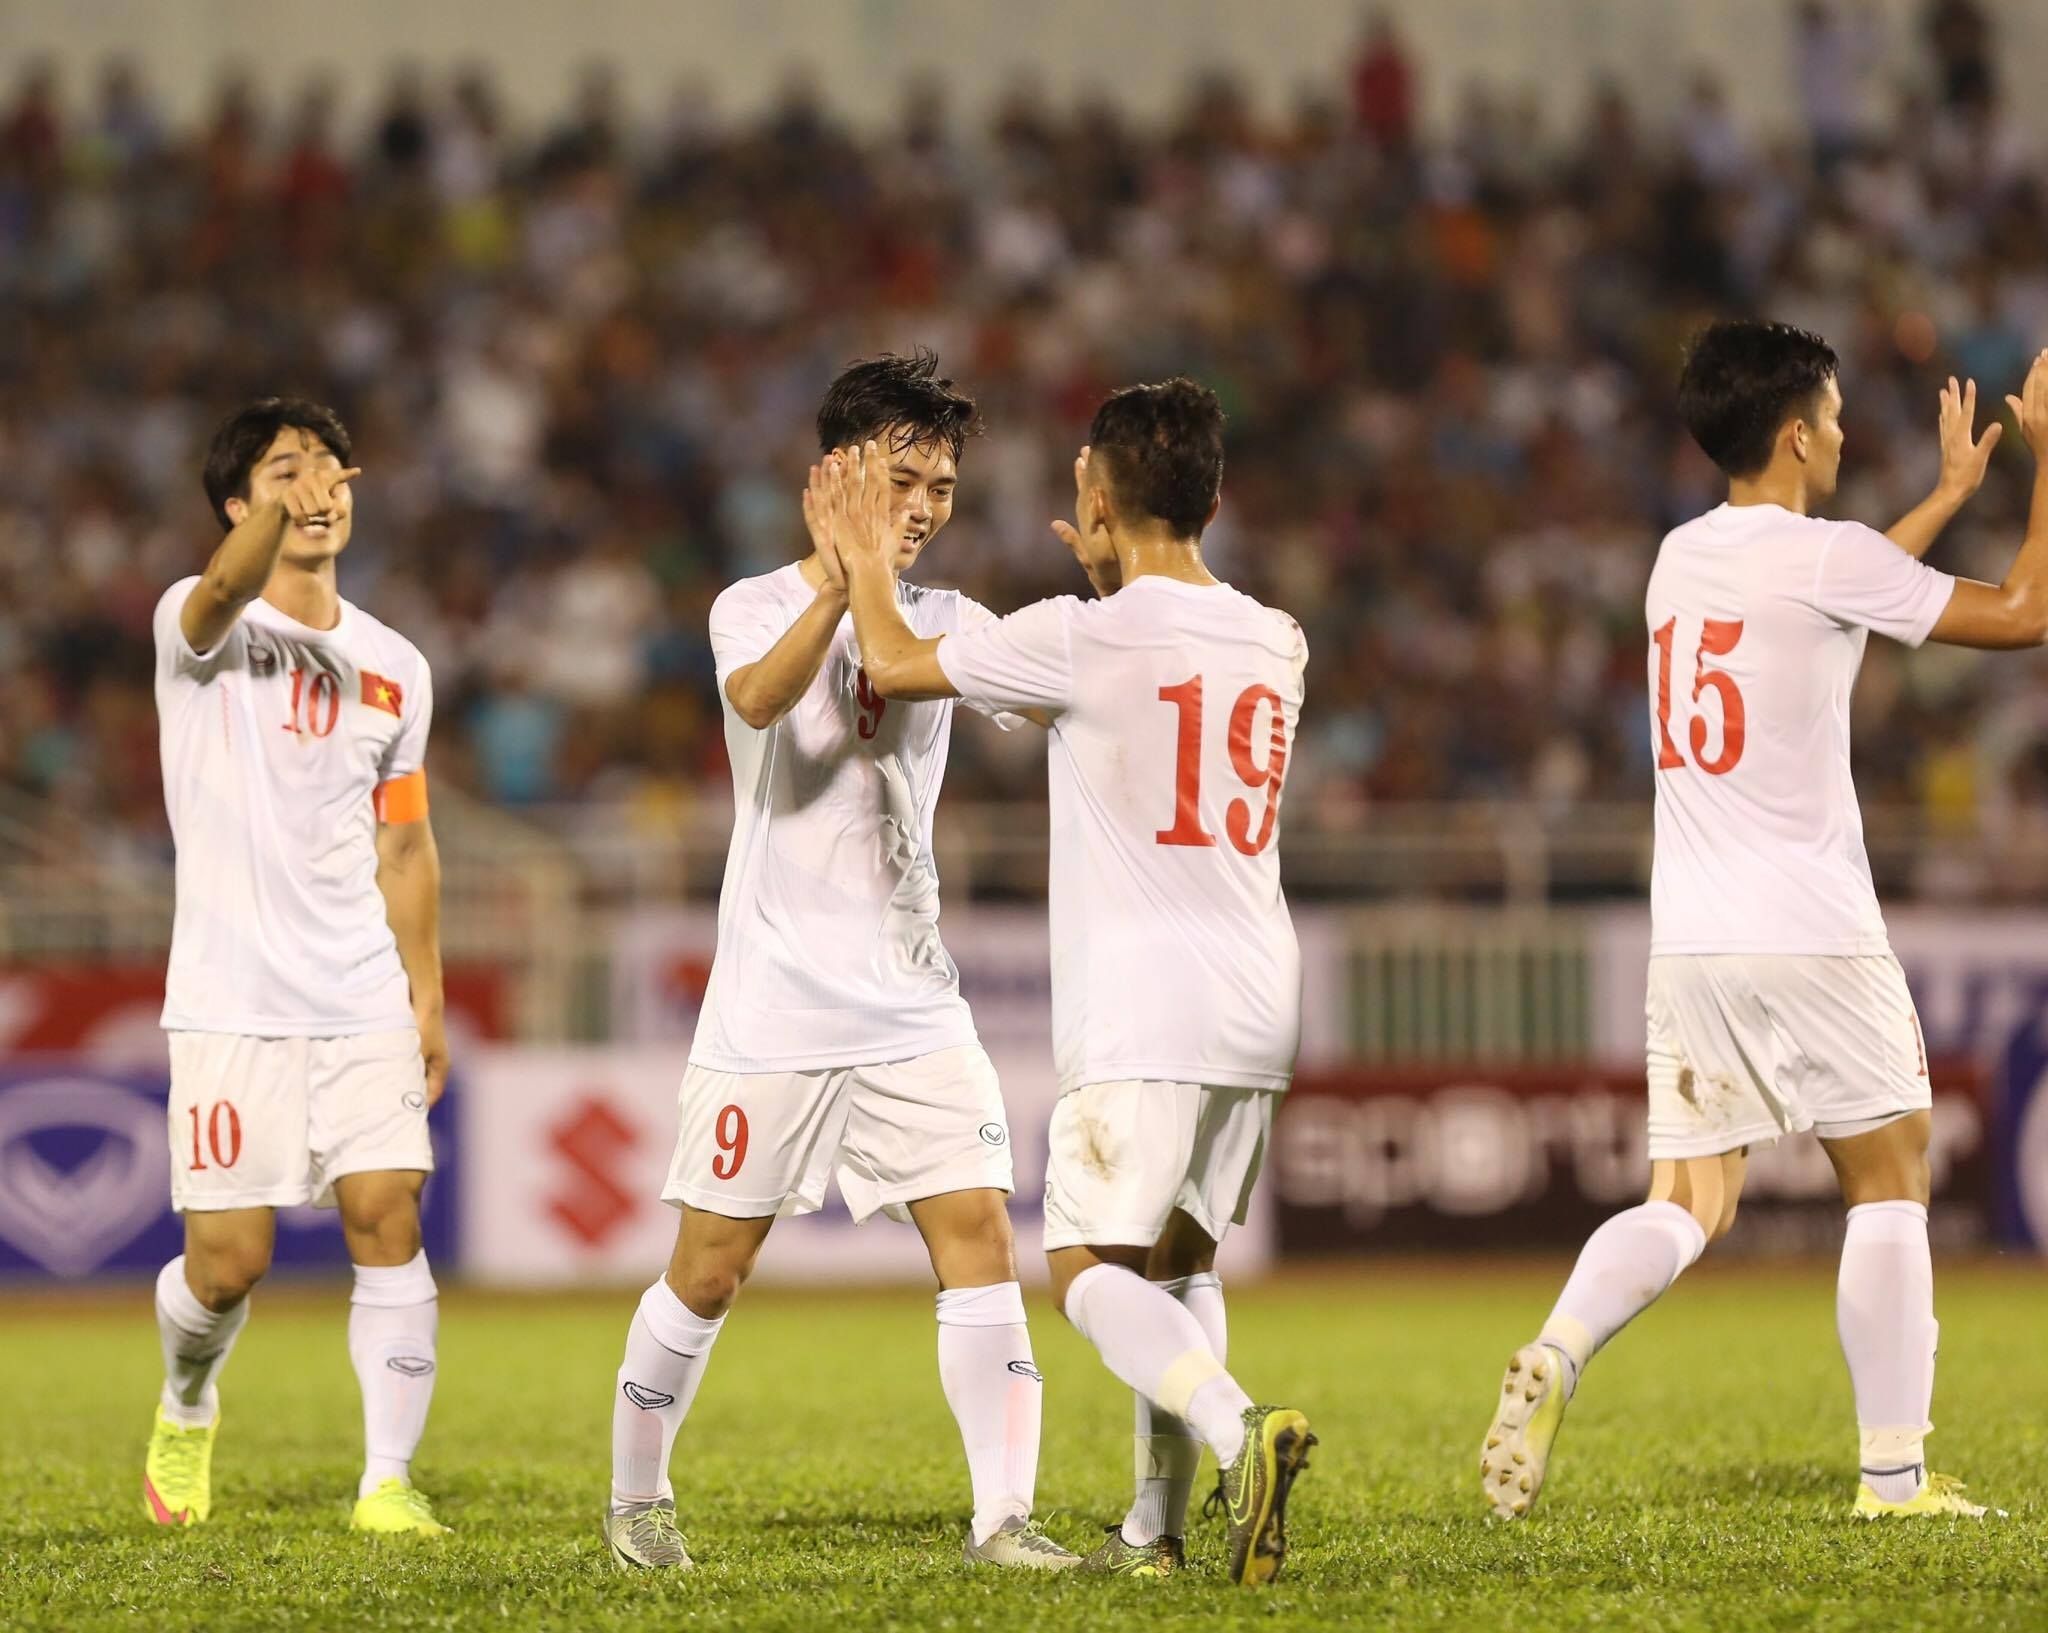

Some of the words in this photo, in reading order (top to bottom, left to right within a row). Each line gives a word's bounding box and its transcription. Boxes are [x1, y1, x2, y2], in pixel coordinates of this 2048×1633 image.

[282, 668, 340, 738] 10
[1654, 615, 1744, 776] 15
[1156, 673, 1286, 857] 19
[188, 1099, 242, 1171] 10
[712, 1104, 750, 1181] 9
